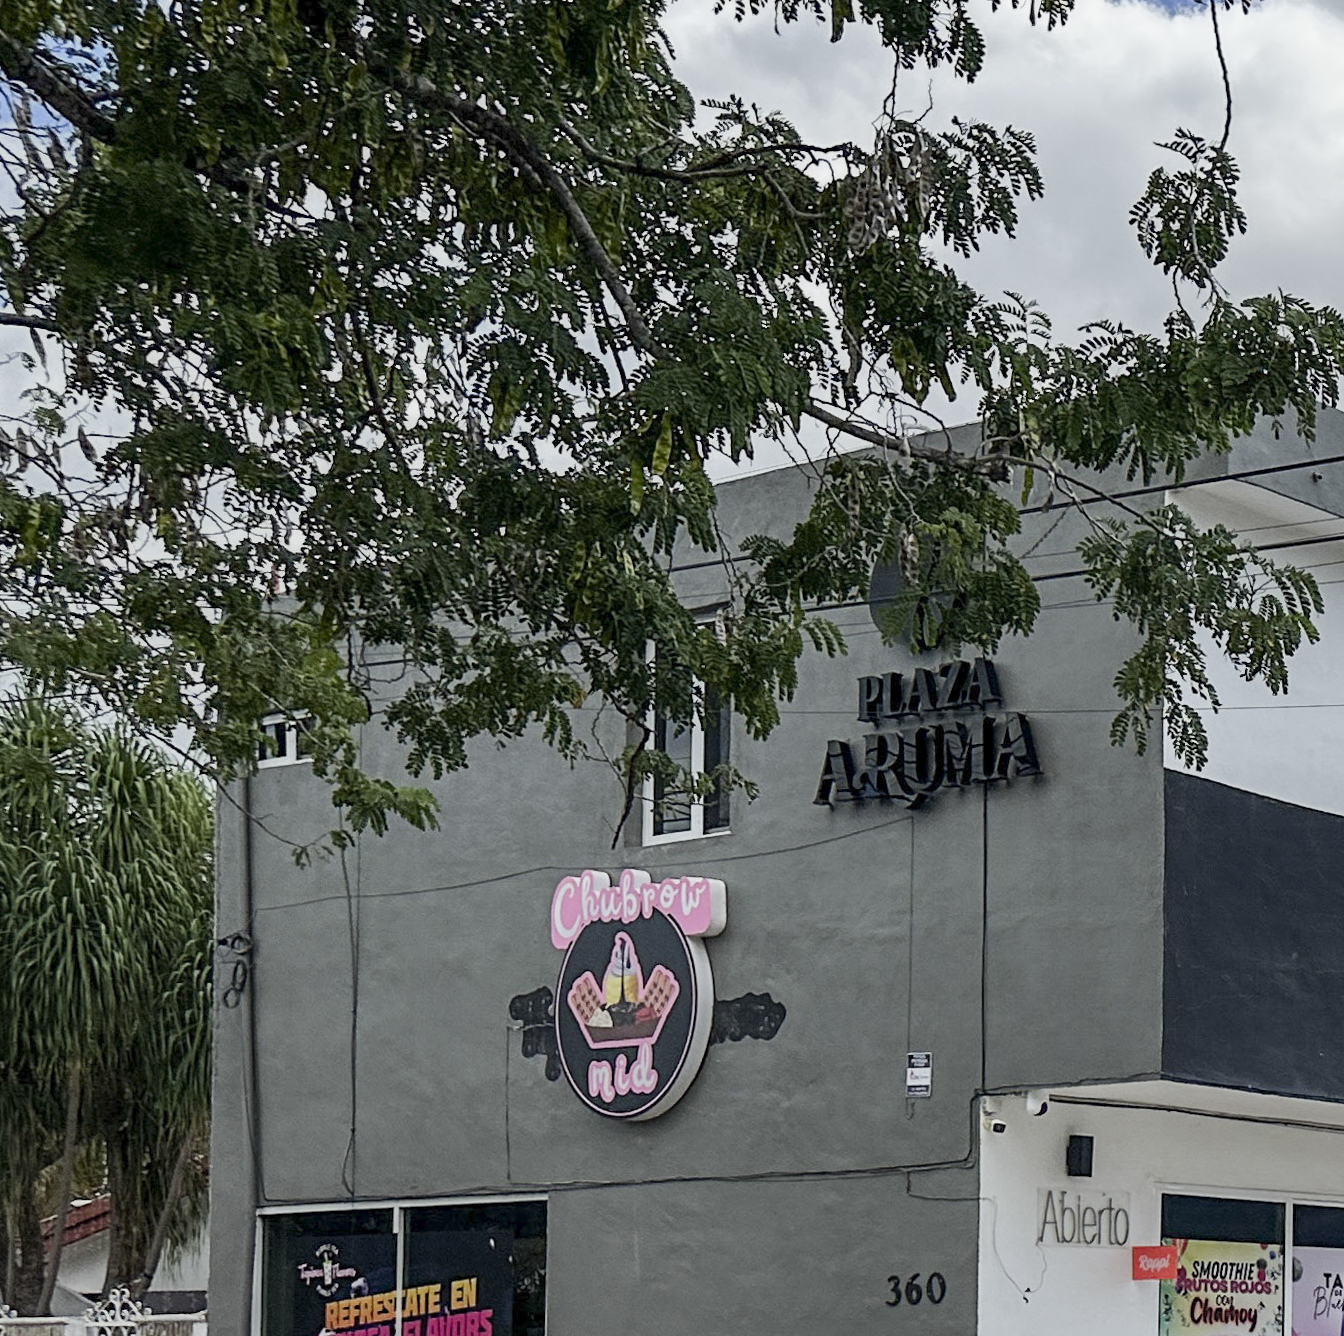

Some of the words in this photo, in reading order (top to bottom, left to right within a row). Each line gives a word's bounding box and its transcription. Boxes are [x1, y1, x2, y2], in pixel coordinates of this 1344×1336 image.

[857, 657, 1001, 723] PLAZA
[554, 874, 707, 938] Chubrow
[590, 1044, 657, 1101] mid
[1040, 1190, 1130, 1246] Abierto
[1192, 1260, 1255, 1280] SMOOTHIE
[1230, 1280, 1272, 1295] ROJOS
[451, 1277, 477, 1309] EN
[885, 1272, 946, 1306] 360
[1190, 1296, 1257, 1332] Chamoy
